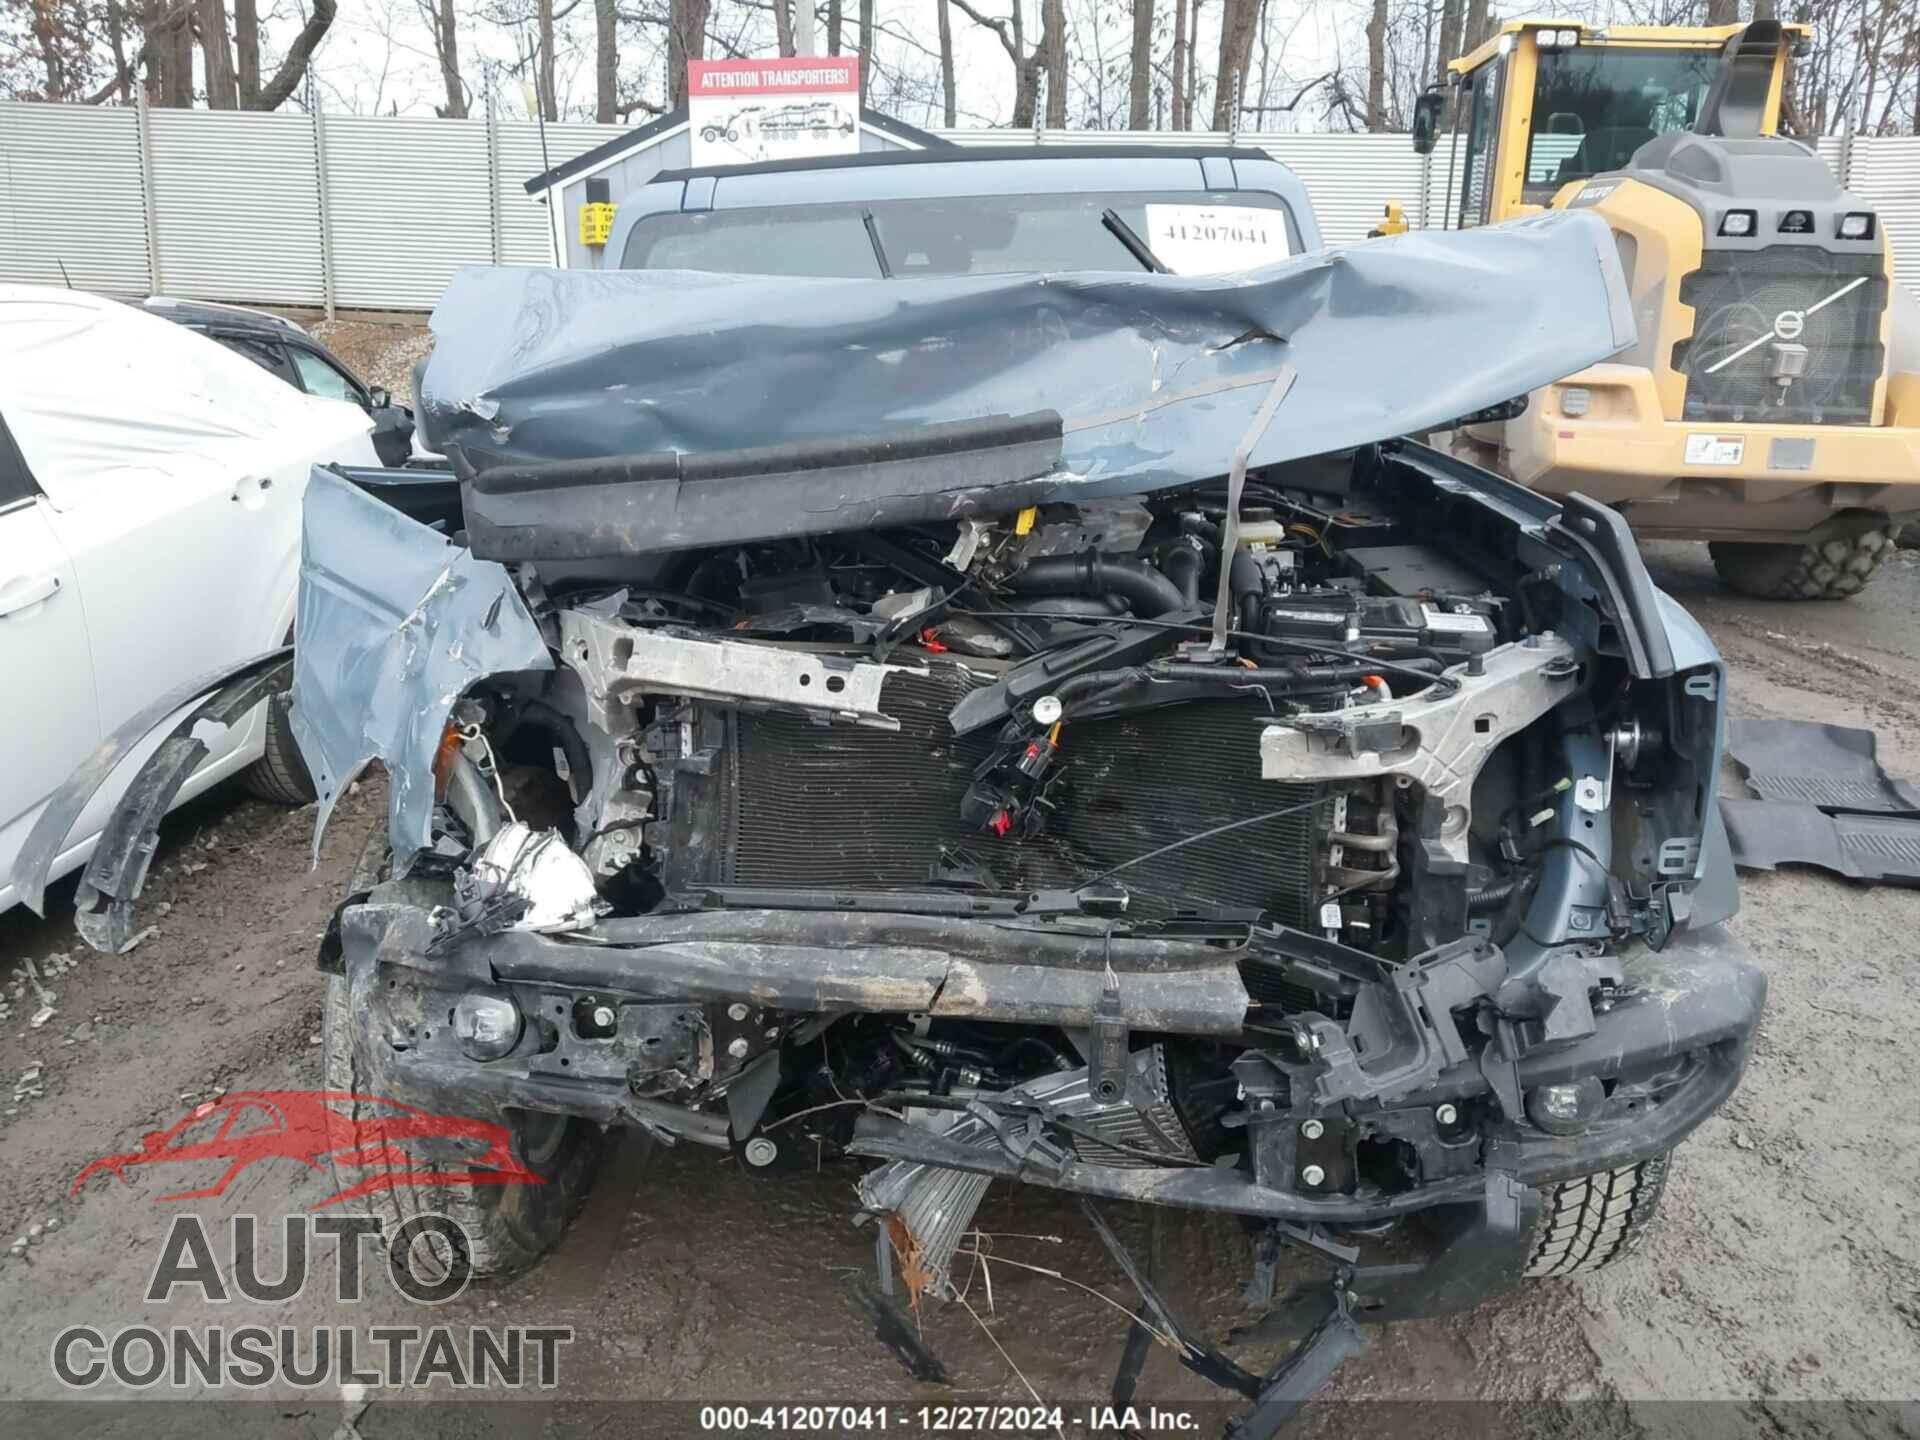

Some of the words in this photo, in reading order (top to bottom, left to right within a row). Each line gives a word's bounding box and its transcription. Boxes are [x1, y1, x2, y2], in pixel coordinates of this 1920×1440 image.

[702, 71, 759, 89] ATTENTION
[761, 68, 849, 86] TRANSPORTERS!
[1163, 224, 1268, 245] 41207041
